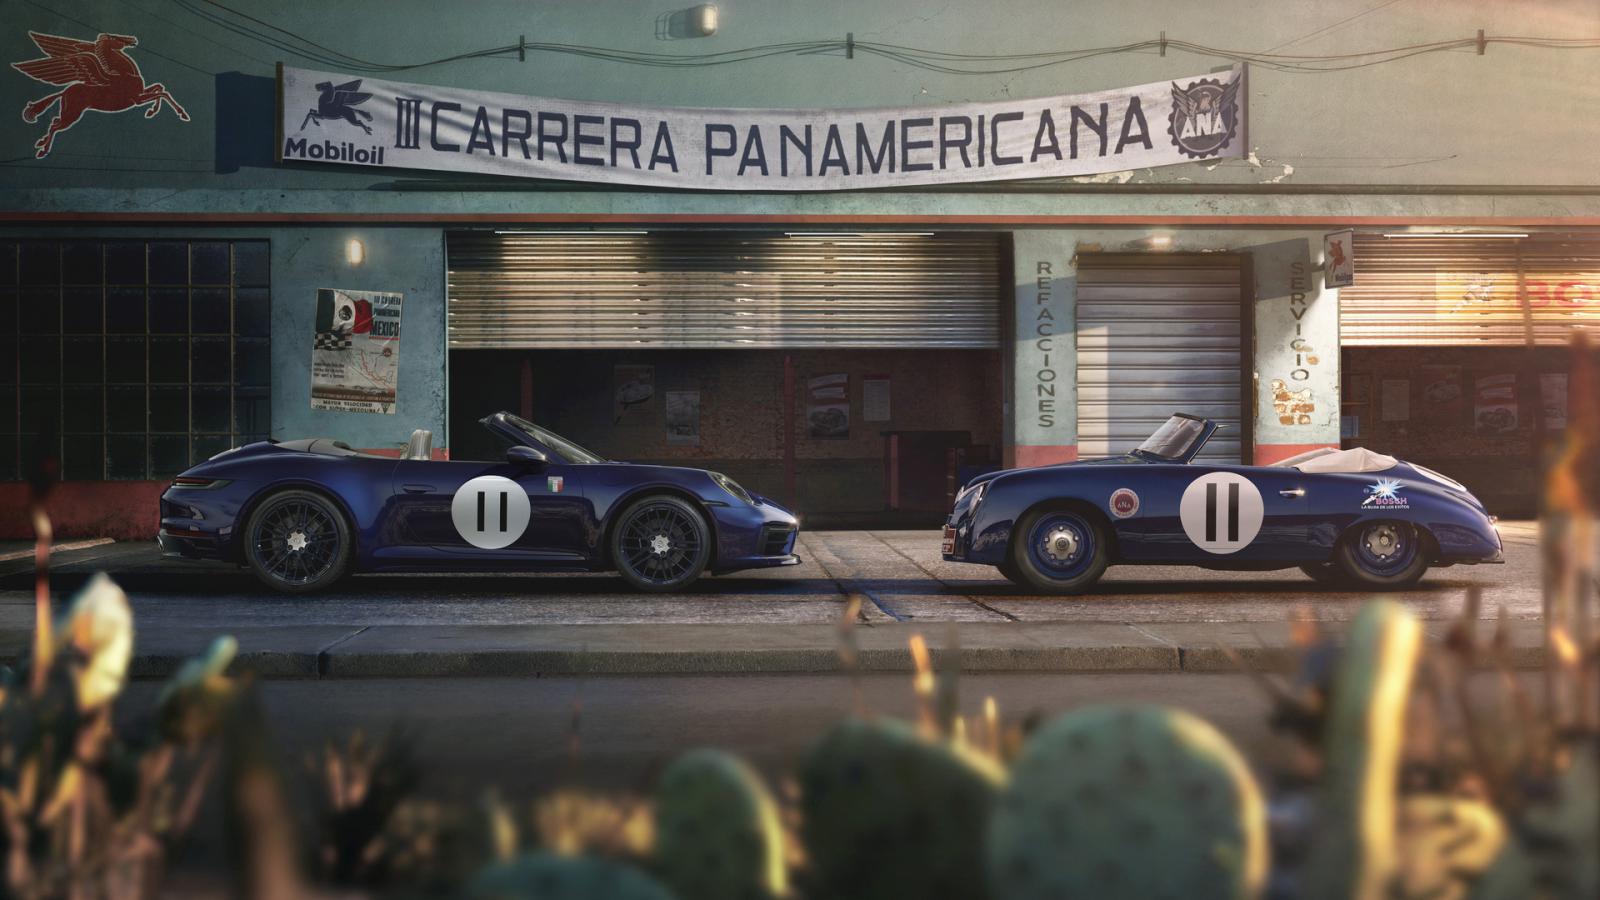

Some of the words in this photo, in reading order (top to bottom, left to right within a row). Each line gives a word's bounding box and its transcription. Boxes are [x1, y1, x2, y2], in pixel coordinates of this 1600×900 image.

[284, 137, 384, 164] Mobiloil
[395, 97, 422, 149] III
[431, 101, 679, 173] CARRERA
[705, 95, 1154, 176] PANAMERICANA
[1180, 111, 1228, 140] ANA
[369, 320, 399, 337] MEXICO
[1036, 261, 1056, 428] REFACCIONES
[1290, 262, 1309, 381] SERVICIO
[477, 491, 507, 532] 11
[1206, 482, 1239, 542] 11
